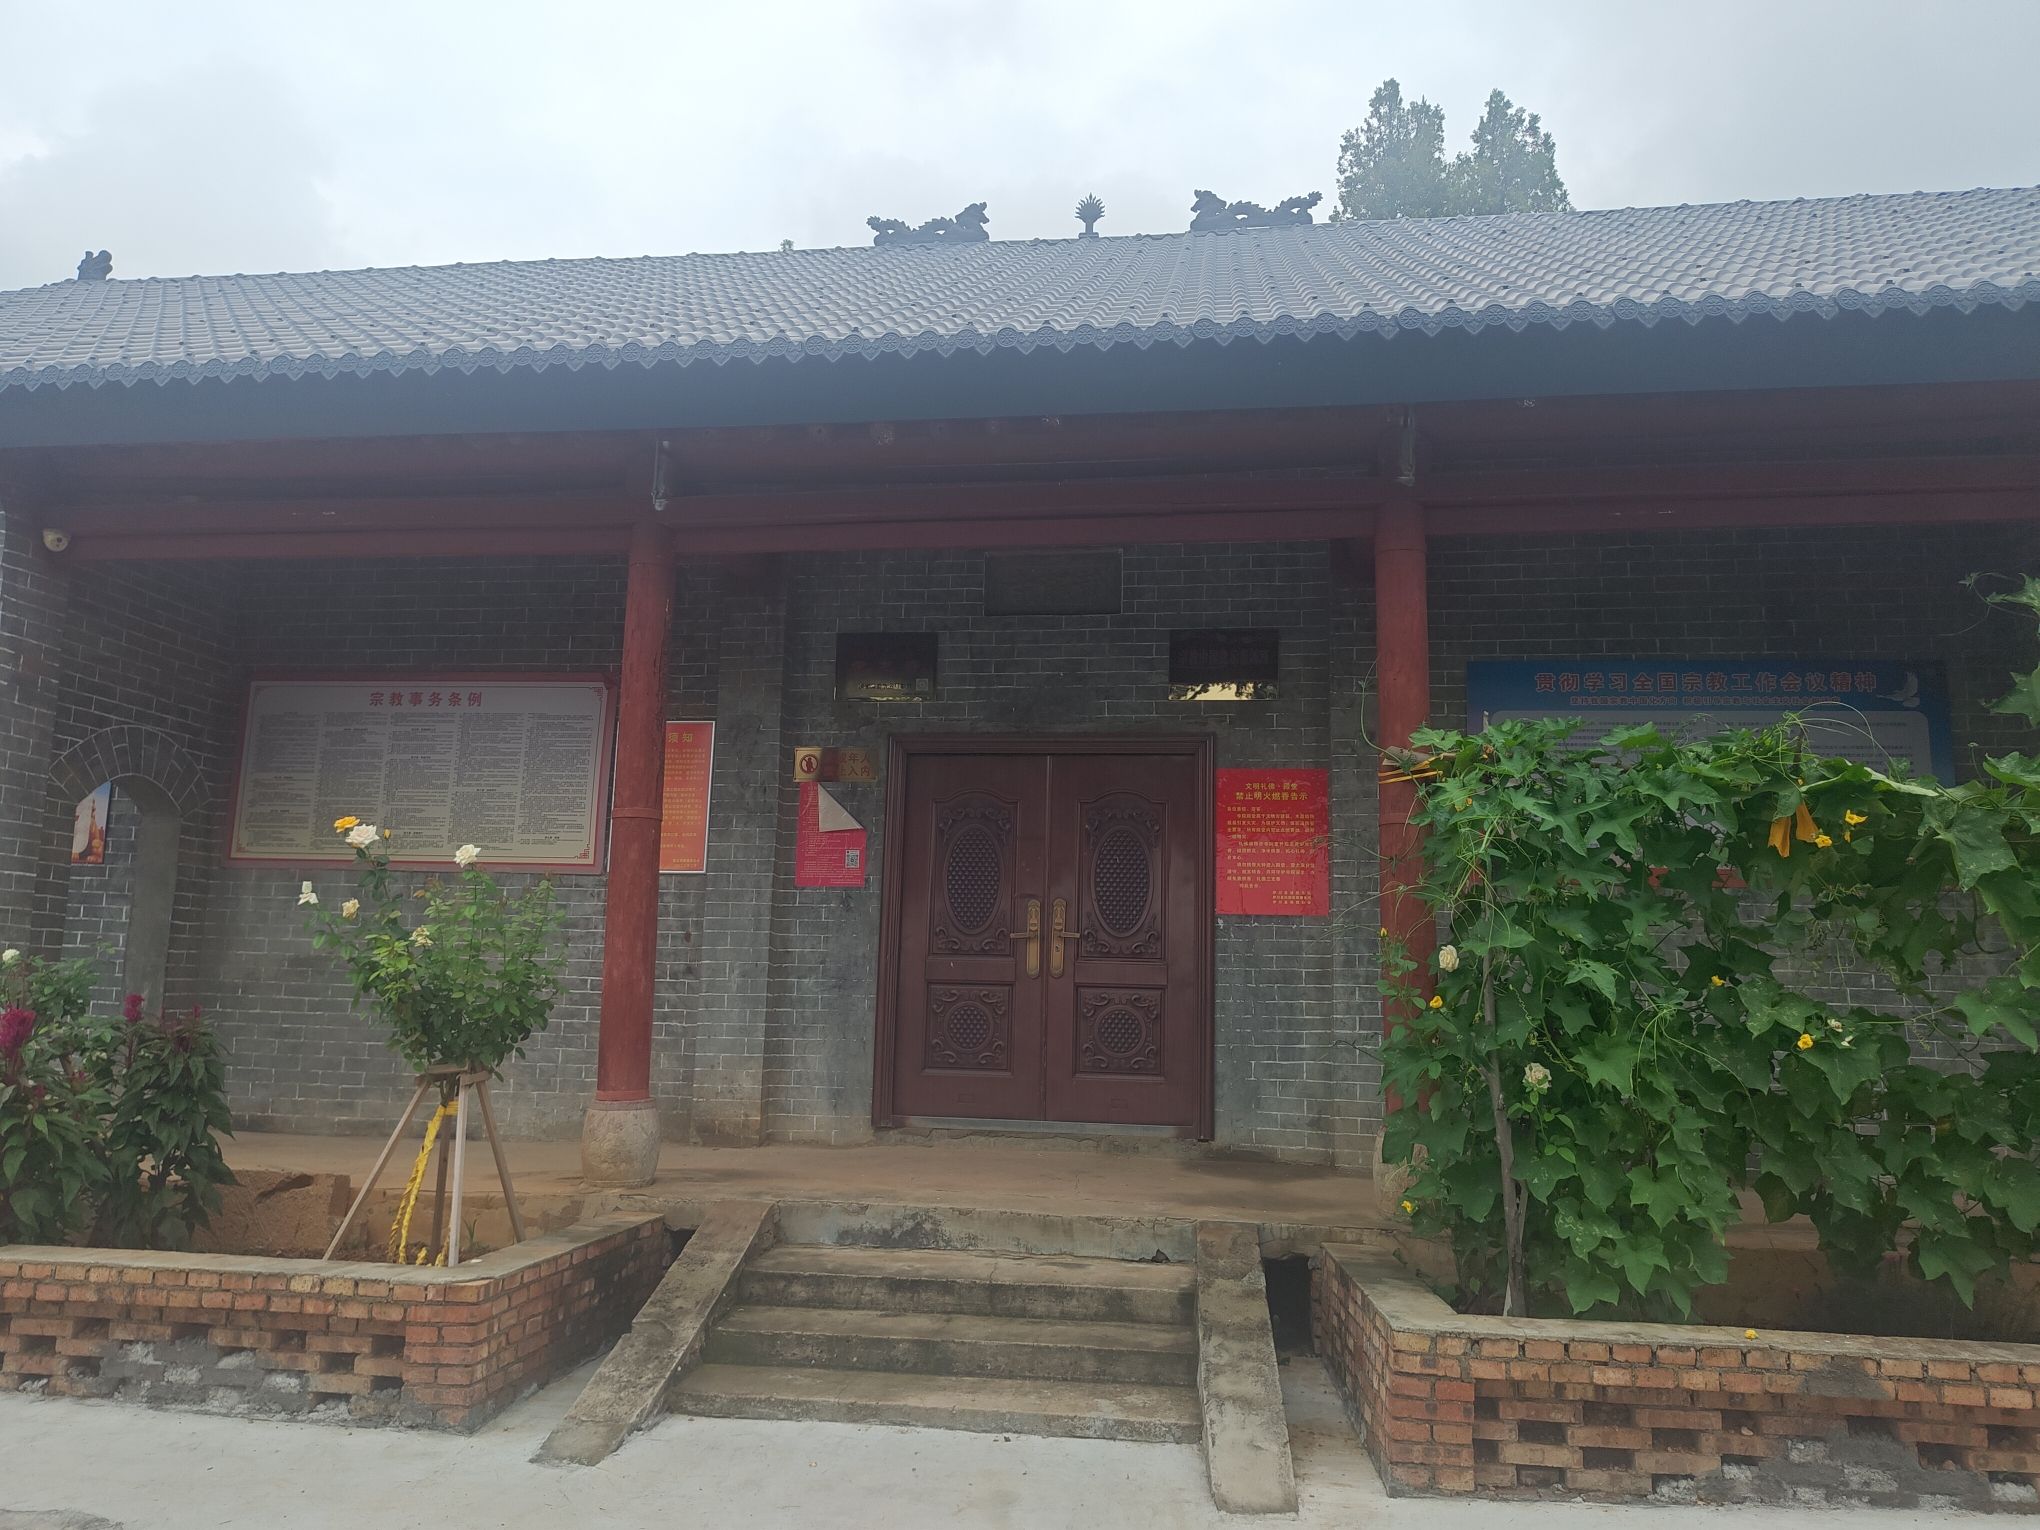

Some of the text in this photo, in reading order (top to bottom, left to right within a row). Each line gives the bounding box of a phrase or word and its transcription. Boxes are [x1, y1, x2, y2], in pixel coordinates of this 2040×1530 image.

[1534, 671, 1878, 694] 贯彻学习全国宗教工作会议精神
[368, 690, 484, 707] 宗教事务条例
[1235, 791, 1308, 800] 禁止明火燃香告示
